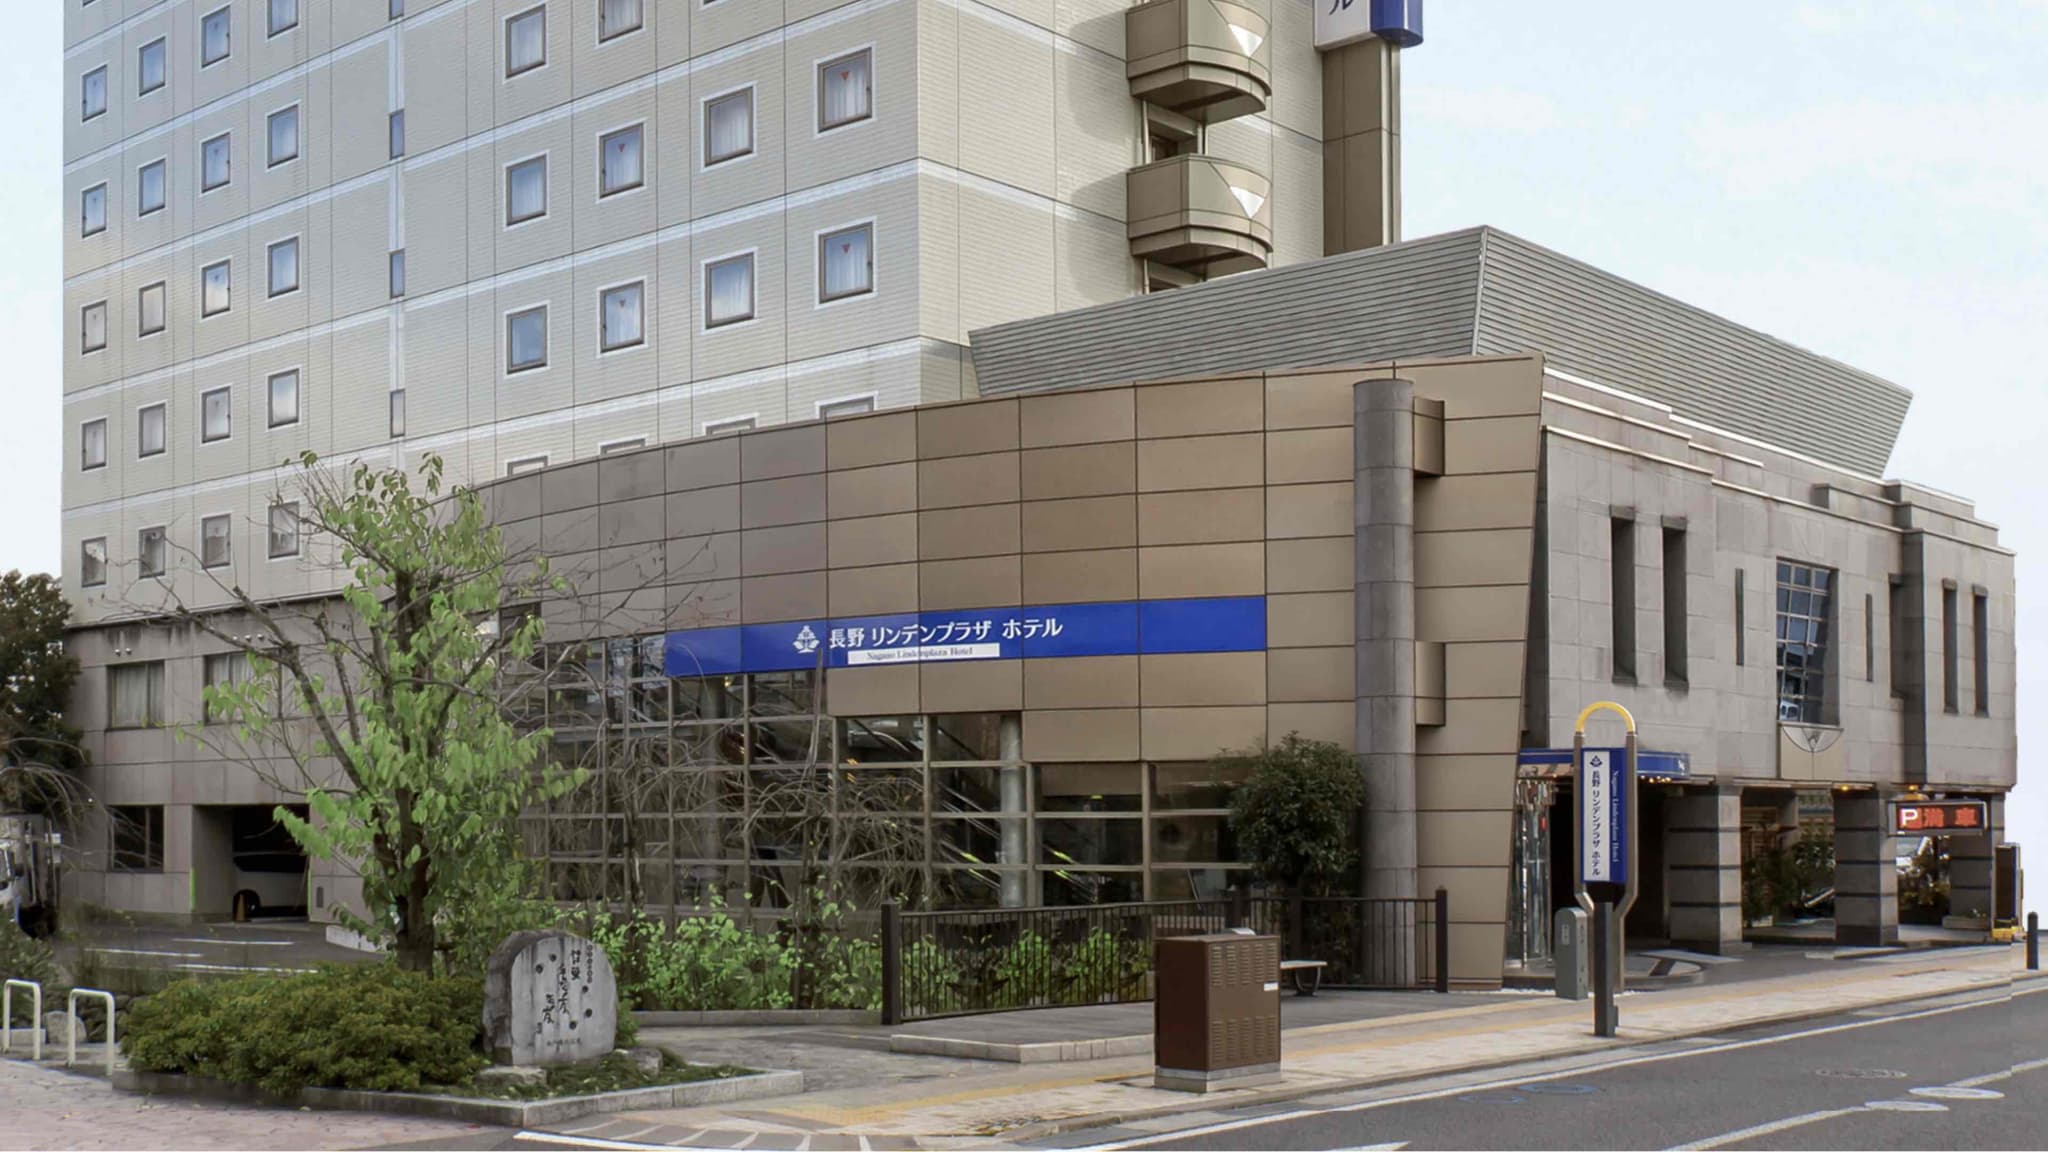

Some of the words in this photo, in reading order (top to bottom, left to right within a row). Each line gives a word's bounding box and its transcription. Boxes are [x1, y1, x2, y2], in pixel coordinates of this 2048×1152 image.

[829, 627, 864, 648] 長野
[872, 620, 992, 645] リンデンプラザ
[1002, 618, 1064, 639] ホテル
[1900, 808, 1918, 827] P
